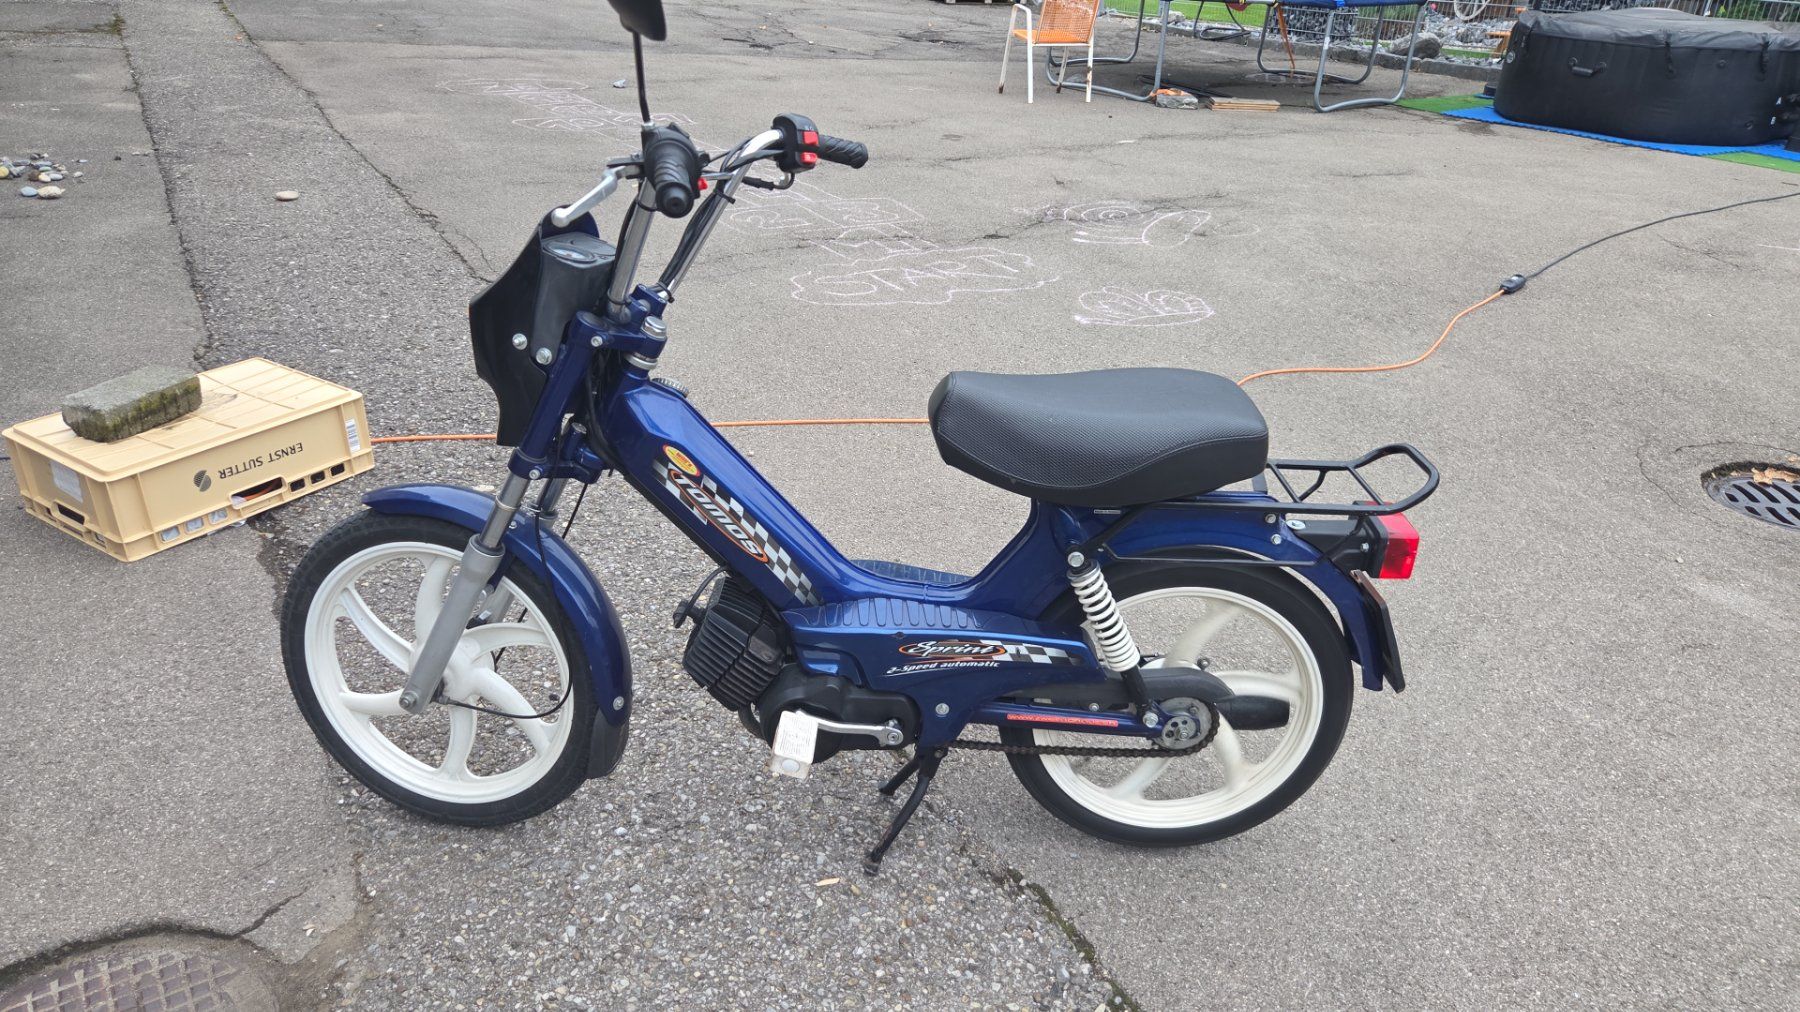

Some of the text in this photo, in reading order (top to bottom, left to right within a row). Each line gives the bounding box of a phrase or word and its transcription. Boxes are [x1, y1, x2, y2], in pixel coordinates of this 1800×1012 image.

[218, 442, 303, 480] ERNST SUTTER
[907, 641, 995, 657] Sprint
